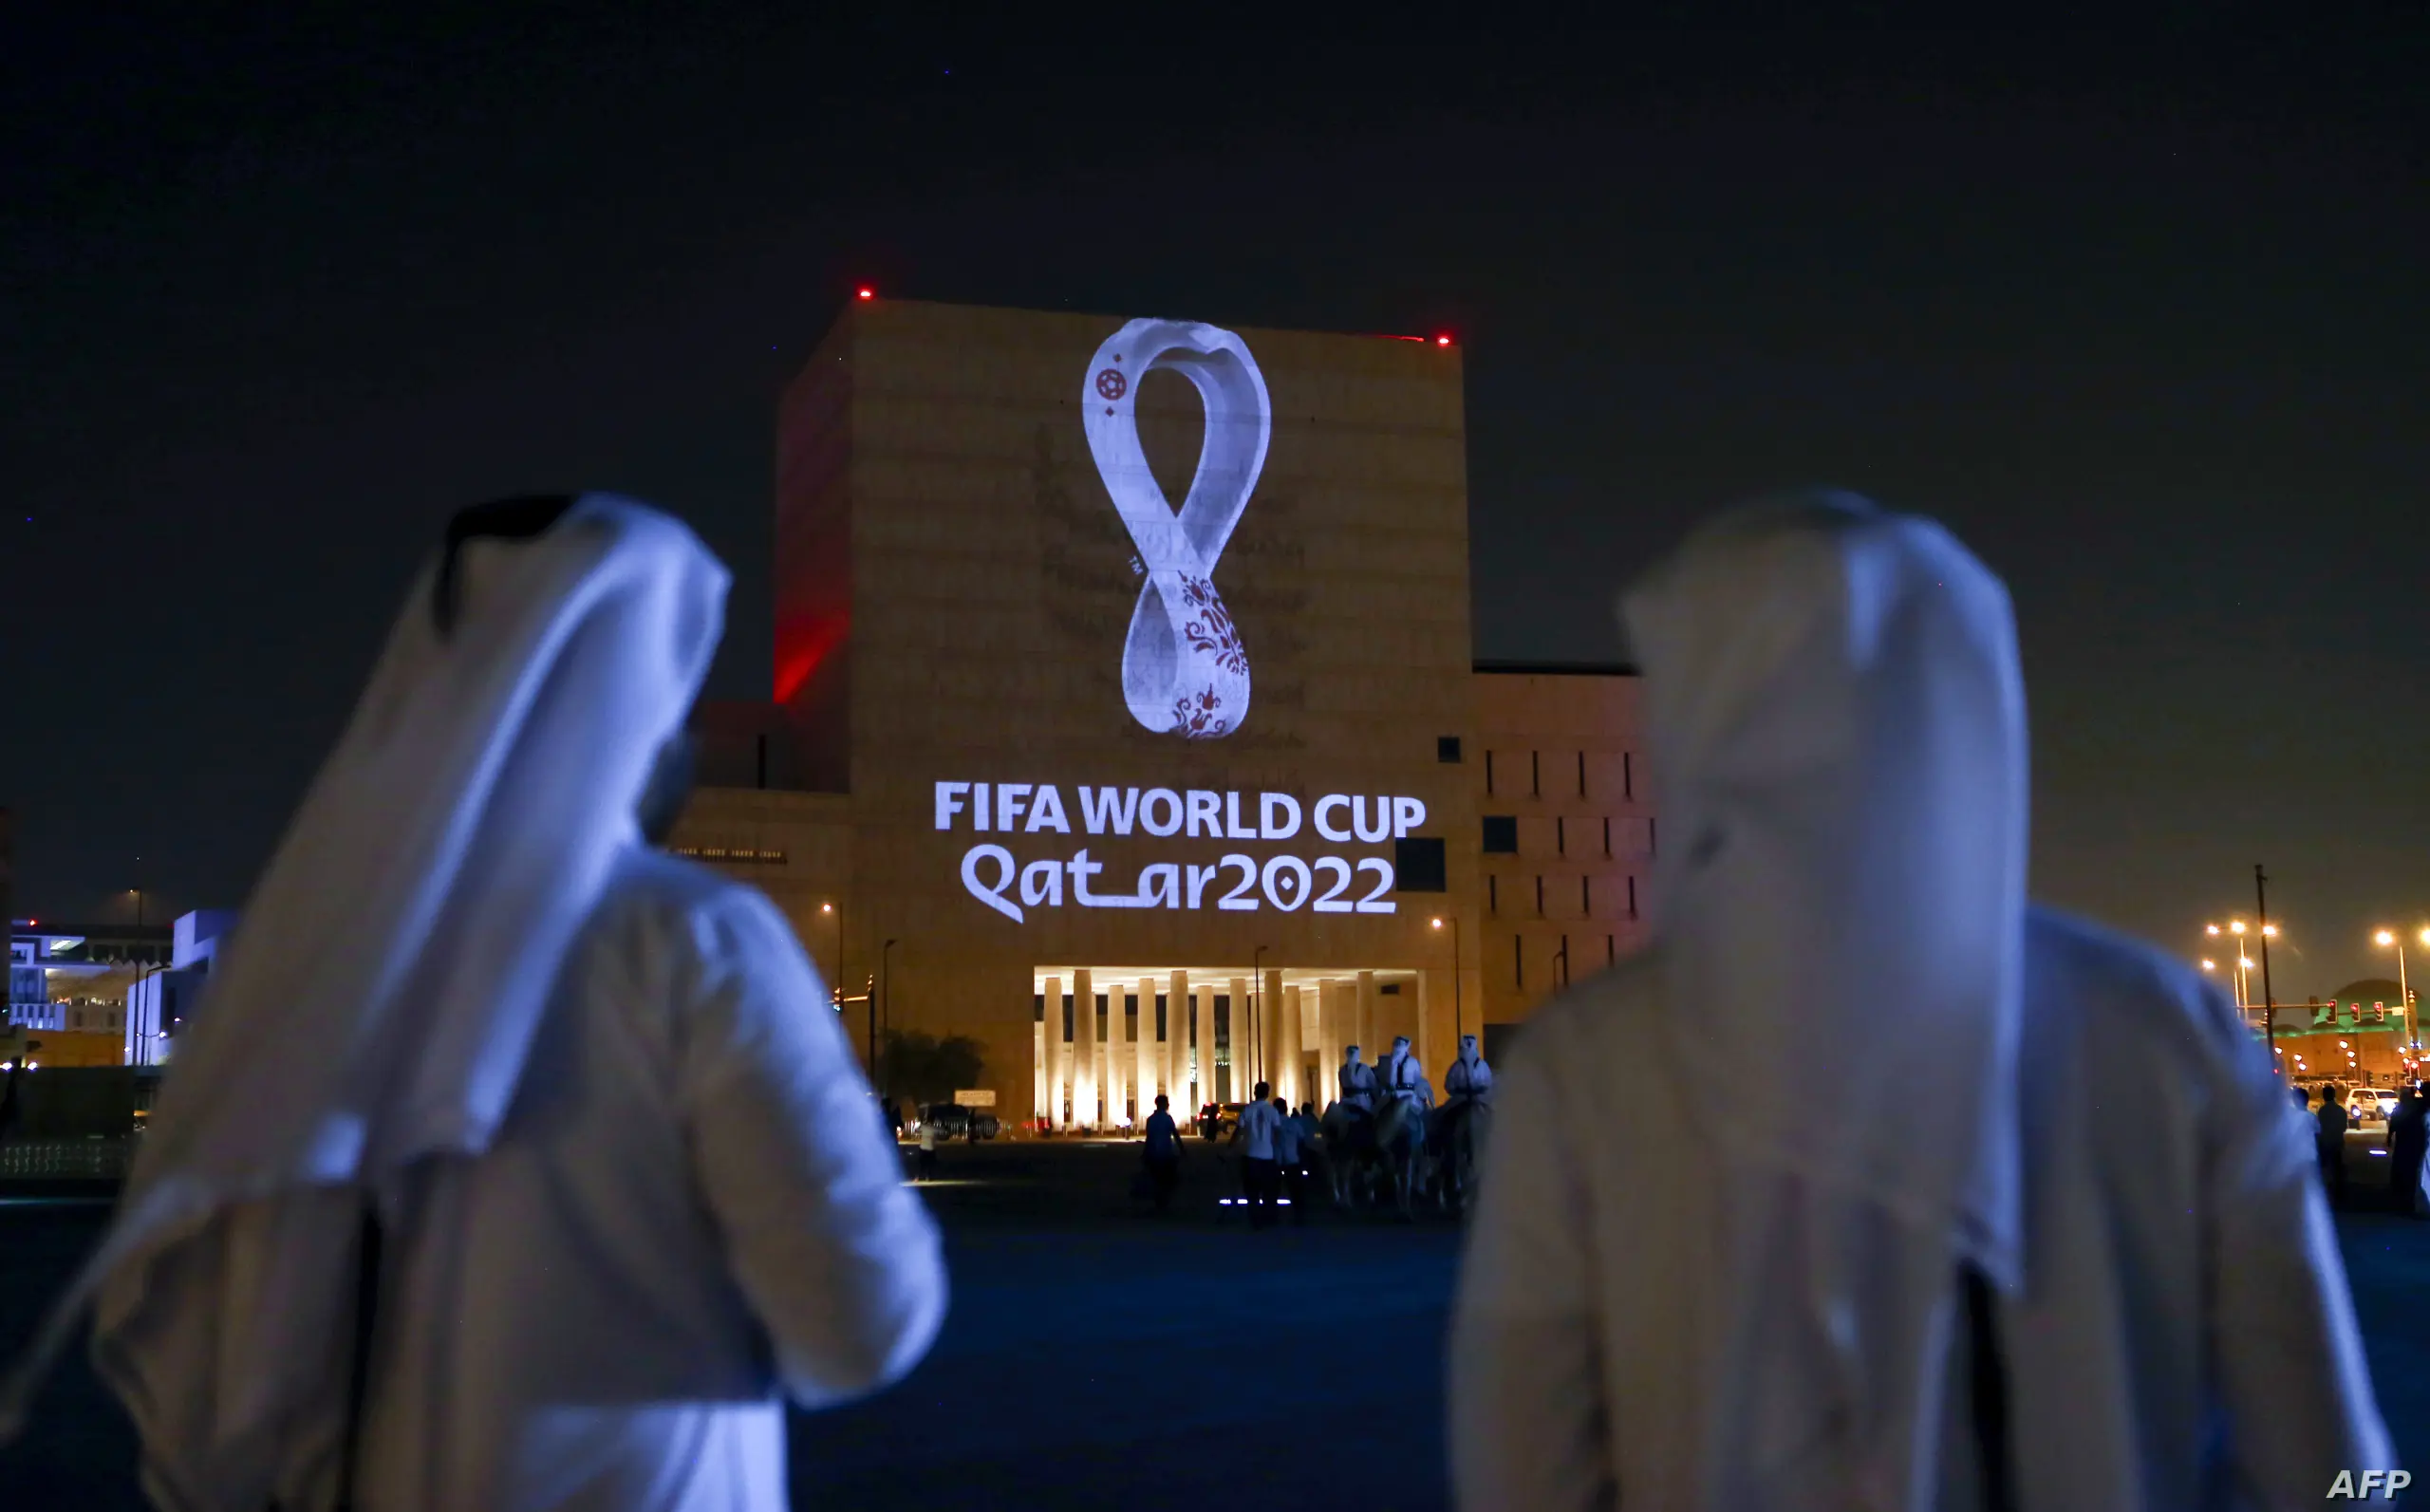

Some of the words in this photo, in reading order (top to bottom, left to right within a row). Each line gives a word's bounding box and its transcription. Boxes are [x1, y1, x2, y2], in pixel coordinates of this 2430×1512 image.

[935, 781, 1071, 833] FIFA
[1078, 785, 1301, 840] WORLD
[1314, 793, 1426, 843] CUP
